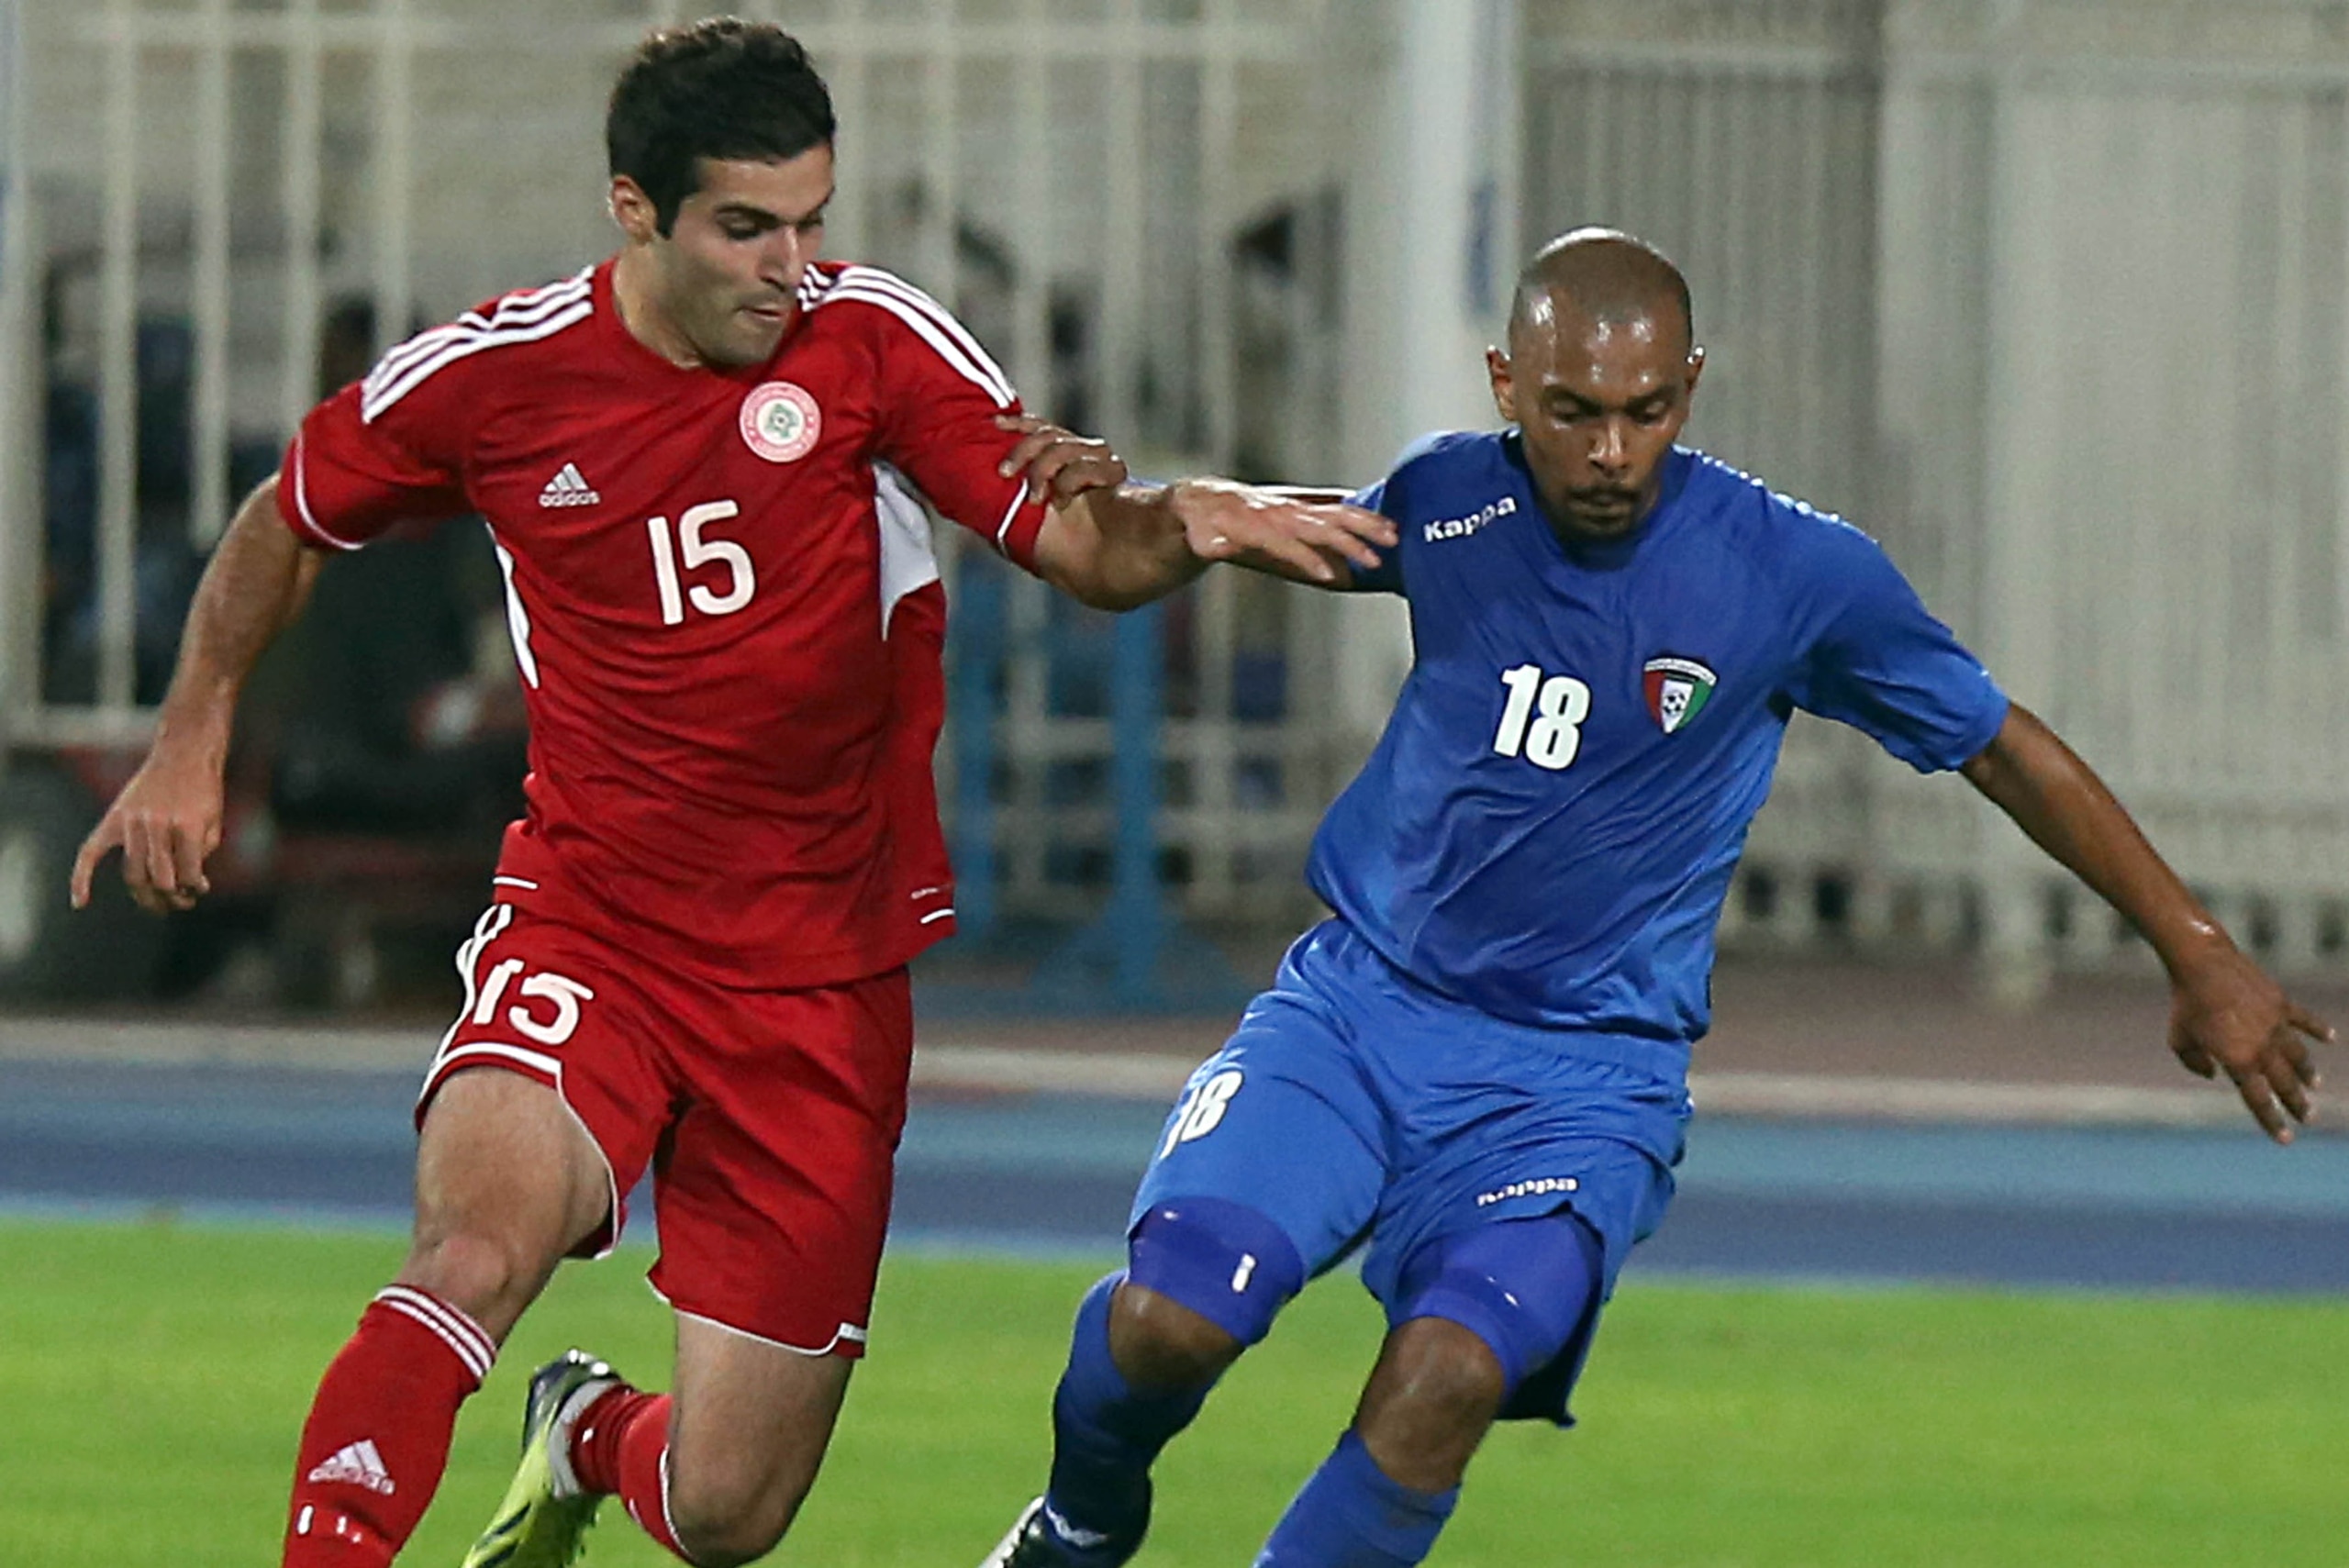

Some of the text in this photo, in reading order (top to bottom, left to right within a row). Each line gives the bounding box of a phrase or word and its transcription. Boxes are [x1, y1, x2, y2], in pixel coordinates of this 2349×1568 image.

[648, 499, 755, 625] 15
[1423, 496, 1517, 542] Kappa
[1493, 663, 1591, 770] 18
[473, 959, 595, 1045] 15
[1159, 1071, 1244, 1160] 18
